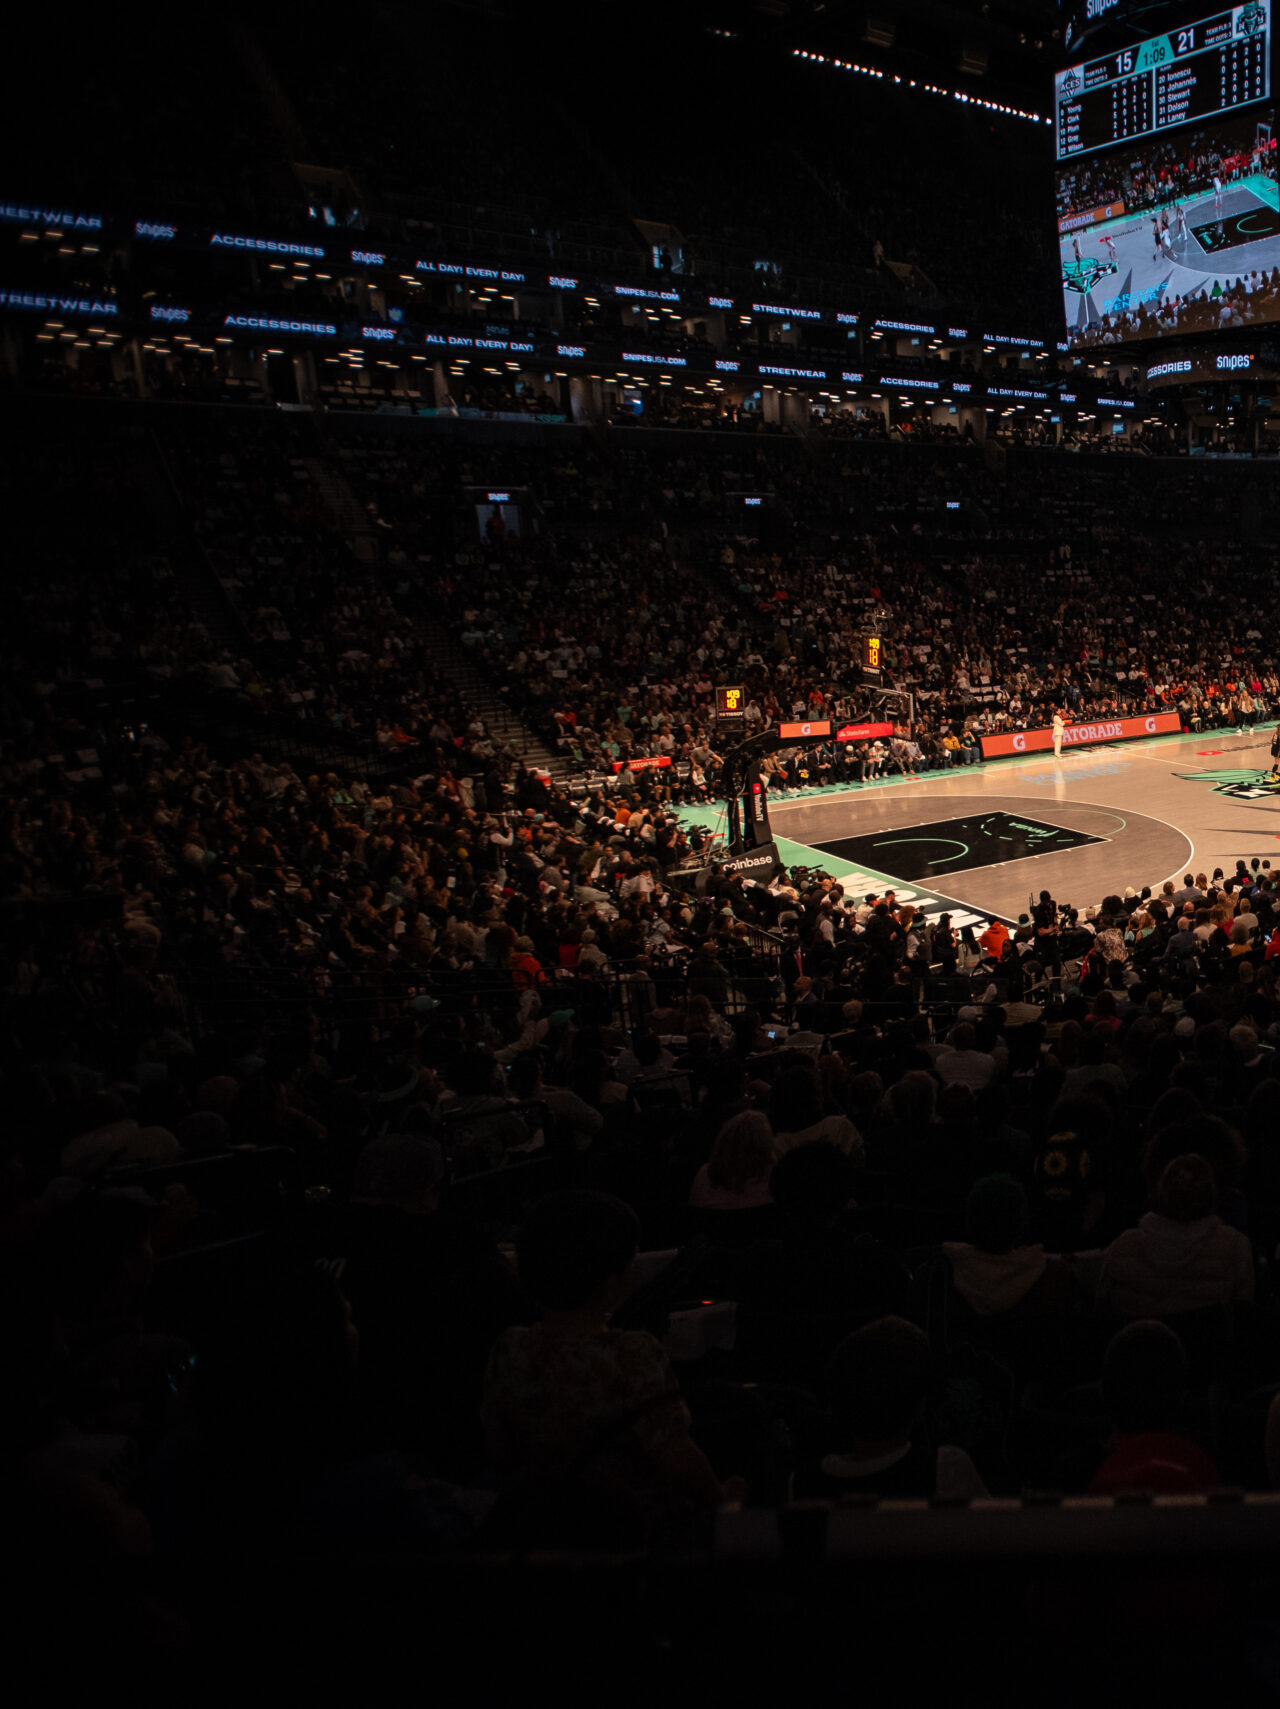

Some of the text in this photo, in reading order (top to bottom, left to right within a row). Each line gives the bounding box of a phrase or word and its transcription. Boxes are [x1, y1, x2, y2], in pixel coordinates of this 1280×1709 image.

[1086, 0, 1119, 19] snip
[1178, 28, 1195, 54] 21
[1116, 50, 1133, 74] 15
[1143, 46, 1166, 66] 1:09
[1168, 68, 1191, 80] Ionescu
[1168, 88, 1191, 102] Stewart
[1168, 100, 1190, 112] Dolson
[1168, 111, 1186, 124] Laney
[1060, 207, 1112, 231] GATORADE G
[136, 220, 175, 240] snipes
[210, 233, 325, 258] ACCESSORIES
[351, 250, 384, 266] snipes
[416, 260, 526, 282] ALL DAY! EVERY DAY!
[550, 275, 577, 290] snipes
[151, 304, 190, 322] snipes
[752, 303, 821, 320] STREETWEAR
[224, 315, 337, 335] ACCESSORIES
[875, 320, 935, 334] ACCESSORIES
[362, 326, 395, 342] snipes
[426, 334, 534, 352] ALL DAY! EVERY DAY!
[558, 345, 585, 358] snipes
[1217, 353, 1250, 371] snipes
[758, 365, 826, 380] STREETWEAR
[880, 377, 940, 390] ACCESSORIES
[802, 724, 810, 736] G
[1145, 718, 1156, 732] G
[1013, 734, 1026, 750] G
